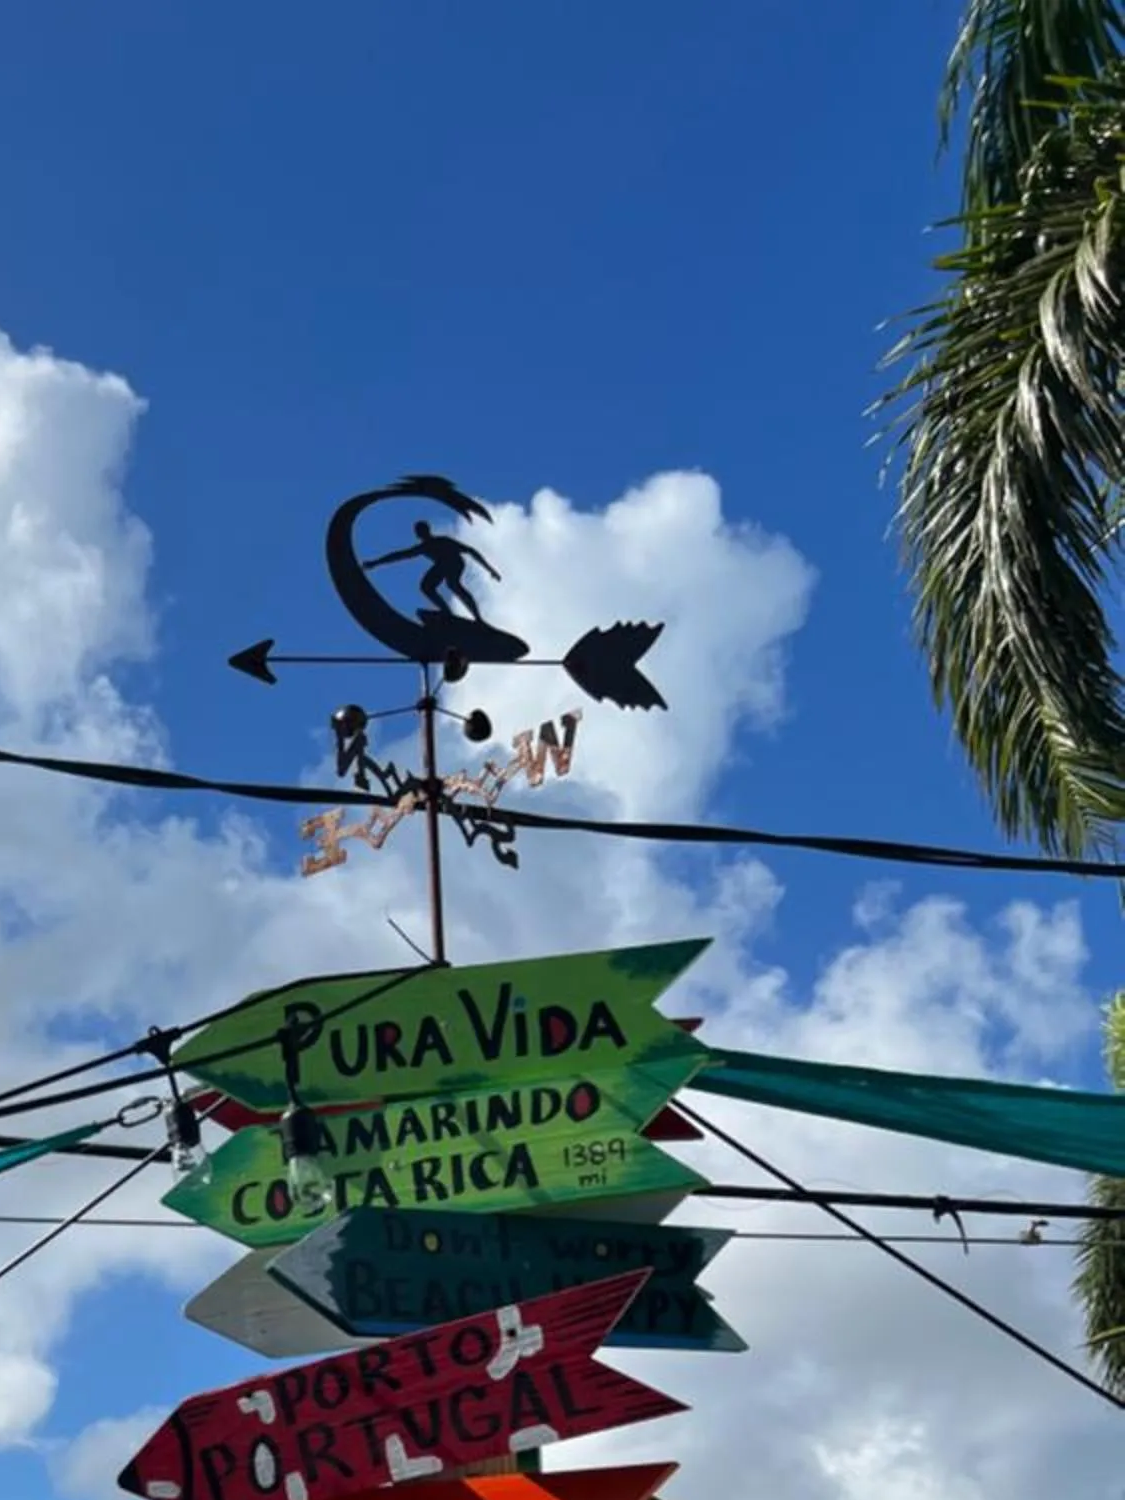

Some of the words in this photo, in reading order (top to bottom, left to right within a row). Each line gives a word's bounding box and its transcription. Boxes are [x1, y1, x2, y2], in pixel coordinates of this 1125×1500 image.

[283, 1002, 454, 1083] PURA
[413, 1141, 539, 1205] RICA
[562, 1137, 627, 1169] 1389
[275, 1326, 493, 1424] PORTO
